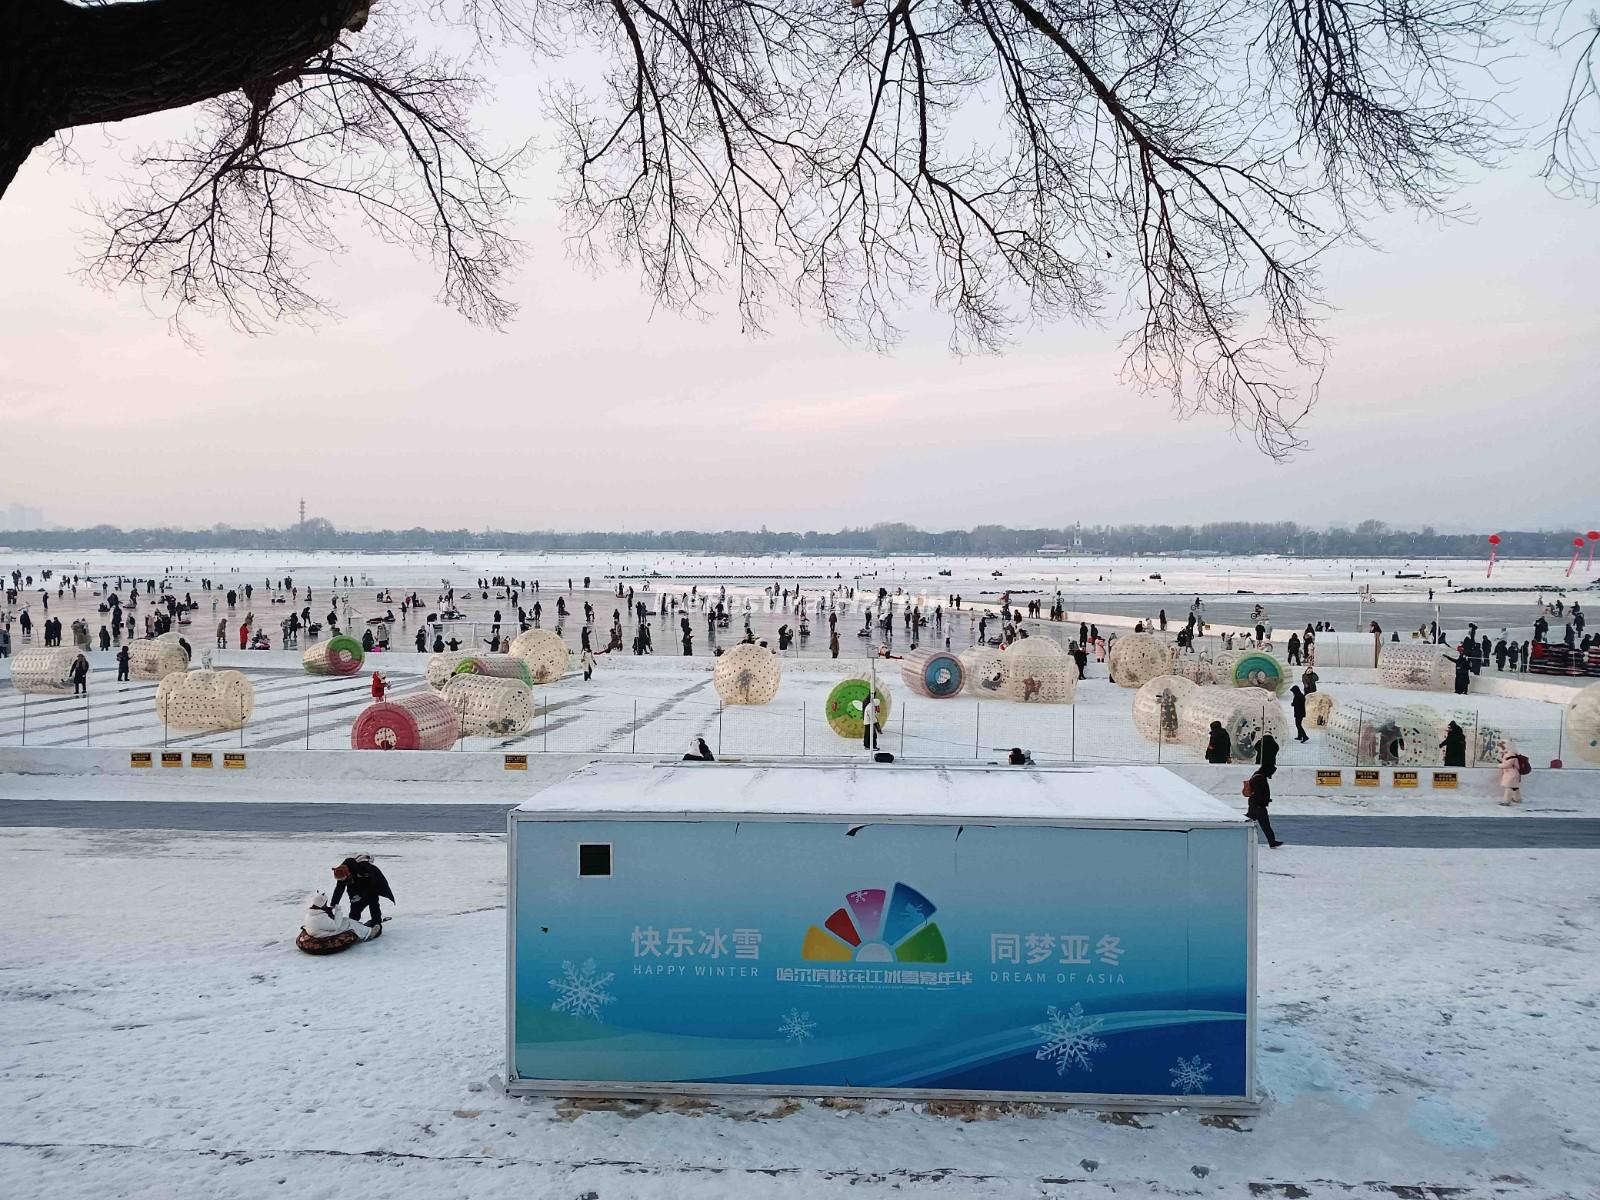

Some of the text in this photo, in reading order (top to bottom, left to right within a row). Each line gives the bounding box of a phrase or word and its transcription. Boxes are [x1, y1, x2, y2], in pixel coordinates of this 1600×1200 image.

[631, 925, 762, 960] 快乐冰雪
[990, 933, 1126, 966] 同梦亚冬
[633, 964, 759, 977] HAPPY WINTER
[776, 967, 973, 986] 哈尔滨松花江冰雪嘉年华
[990, 971, 1125, 984] DREAM OF ASIA
